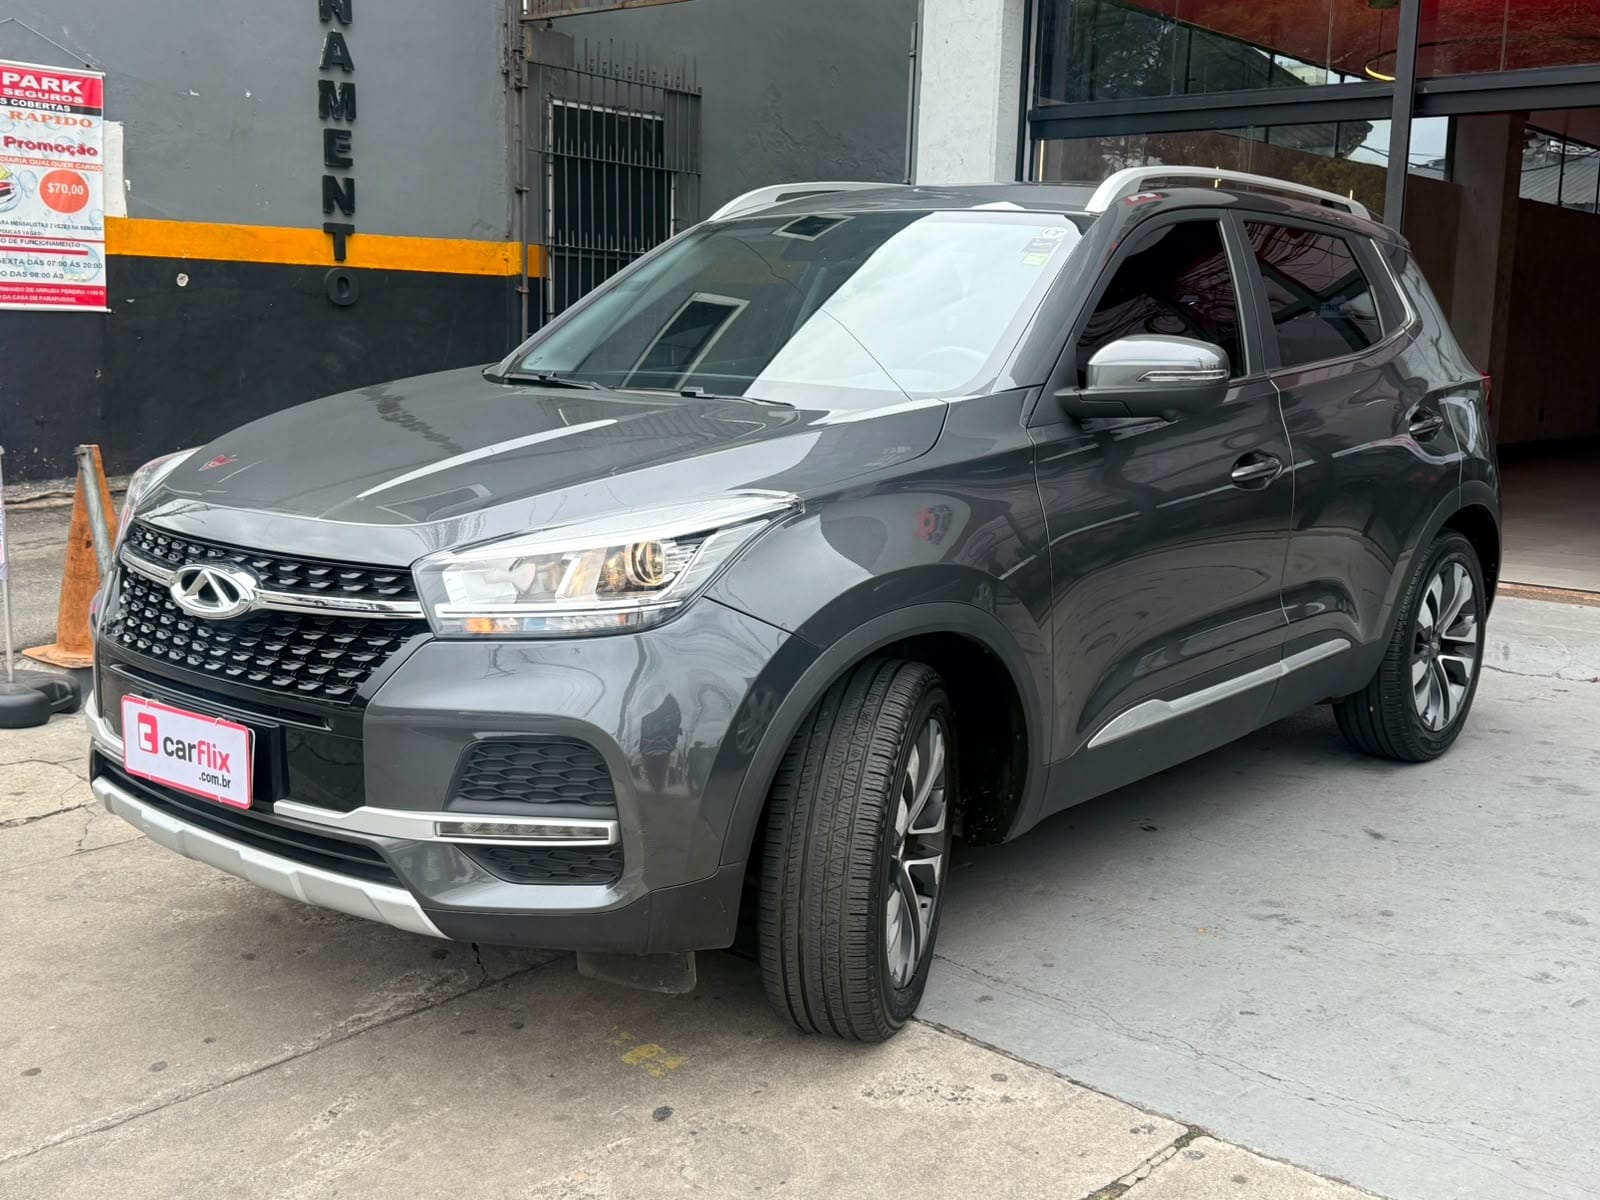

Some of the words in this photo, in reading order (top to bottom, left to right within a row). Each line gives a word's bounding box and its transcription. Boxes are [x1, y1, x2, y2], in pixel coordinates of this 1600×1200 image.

[2, 72, 83, 95] PARK
[3, 88, 84, 104] SEGUROS
[11, 99, 71, 112] COBERTAS
[3, 135, 98, 157] Promoção
[47, 182, 84, 196] $70,00
[20, 239, 81, 248] FUNCIONAMENTO
[163, 736, 231, 773] carflix
[199, 771, 231, 789] .com.br
